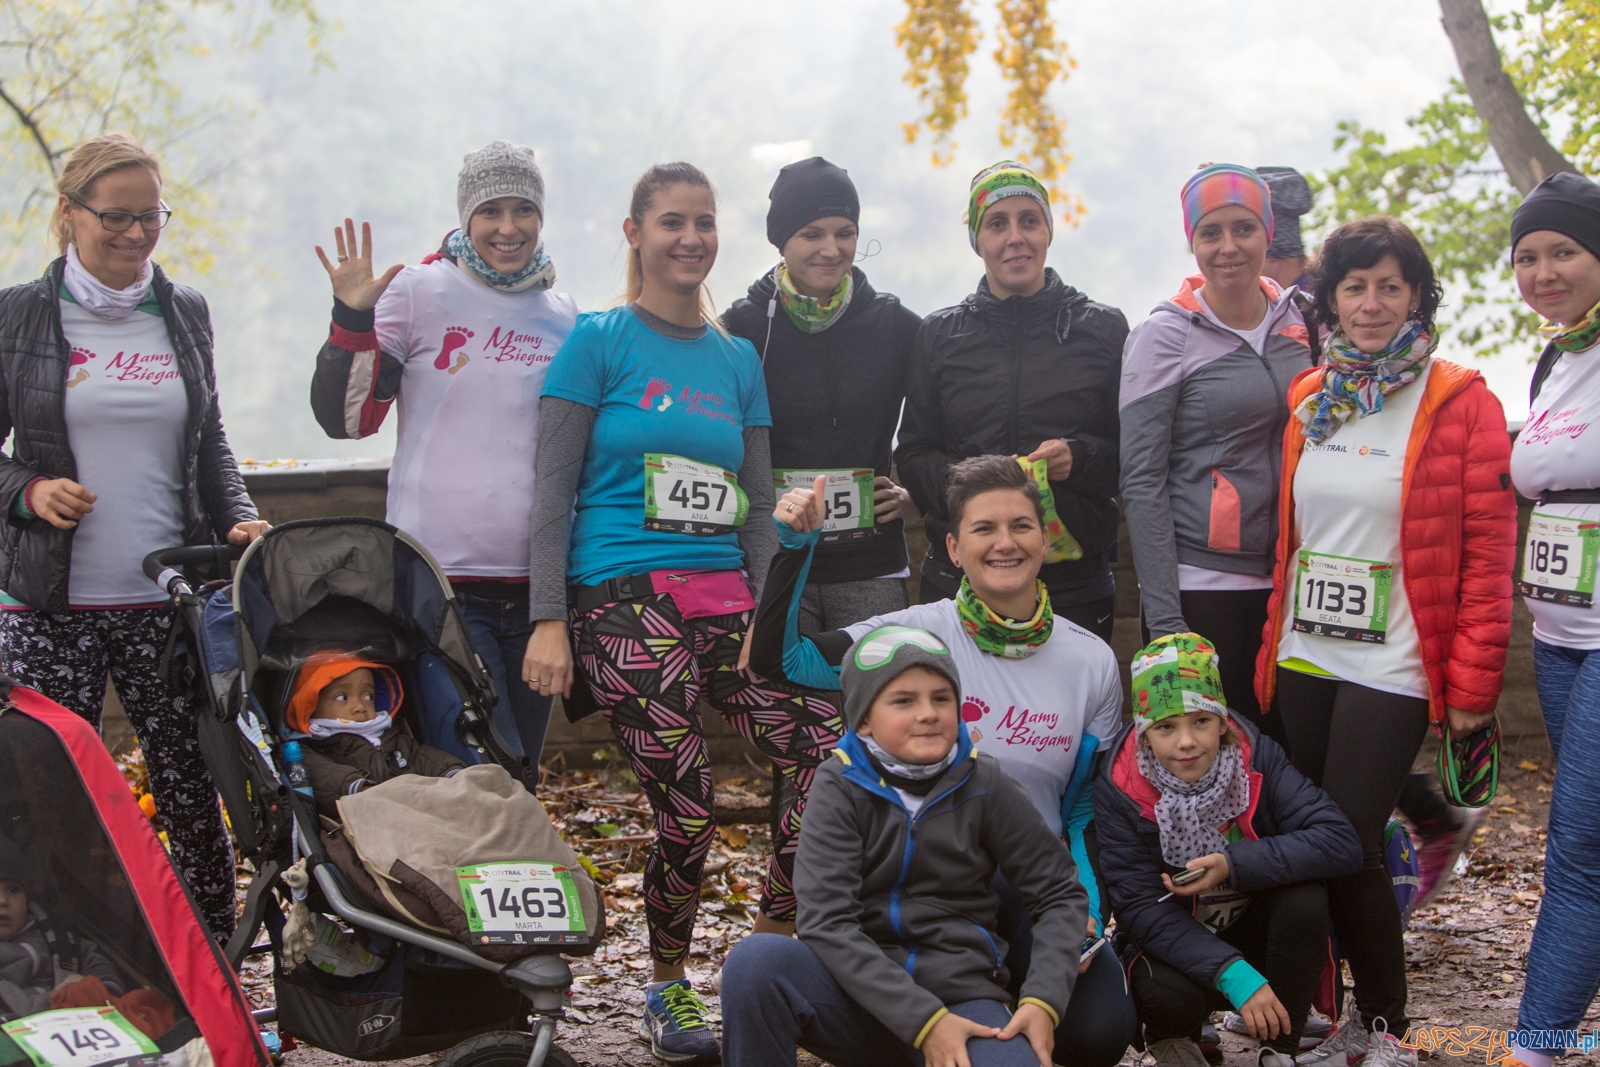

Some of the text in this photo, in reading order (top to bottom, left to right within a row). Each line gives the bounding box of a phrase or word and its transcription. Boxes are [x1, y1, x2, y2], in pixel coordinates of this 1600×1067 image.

[483, 326, 543, 352] Mamy
[105, 351, 174, 371] Mamy
[677, 386, 724, 407] Mamy
[668, 479, 728, 512] 457
[691, 513, 709, 521] ANIA
[1530, 539, 1569, 576] 185
[1306, 578, 1367, 616] 1133
[1376, 595, 1385, 623] Poznań
[1319, 613, 1342, 624] BEATA
[996, 705, 1059, 731] Mamy
[480, 887, 567, 918] 1463
[569, 895, 580, 923] Poznań
[515, 922, 543, 930] MARTA
[51, 1027, 121, 1056] 149
